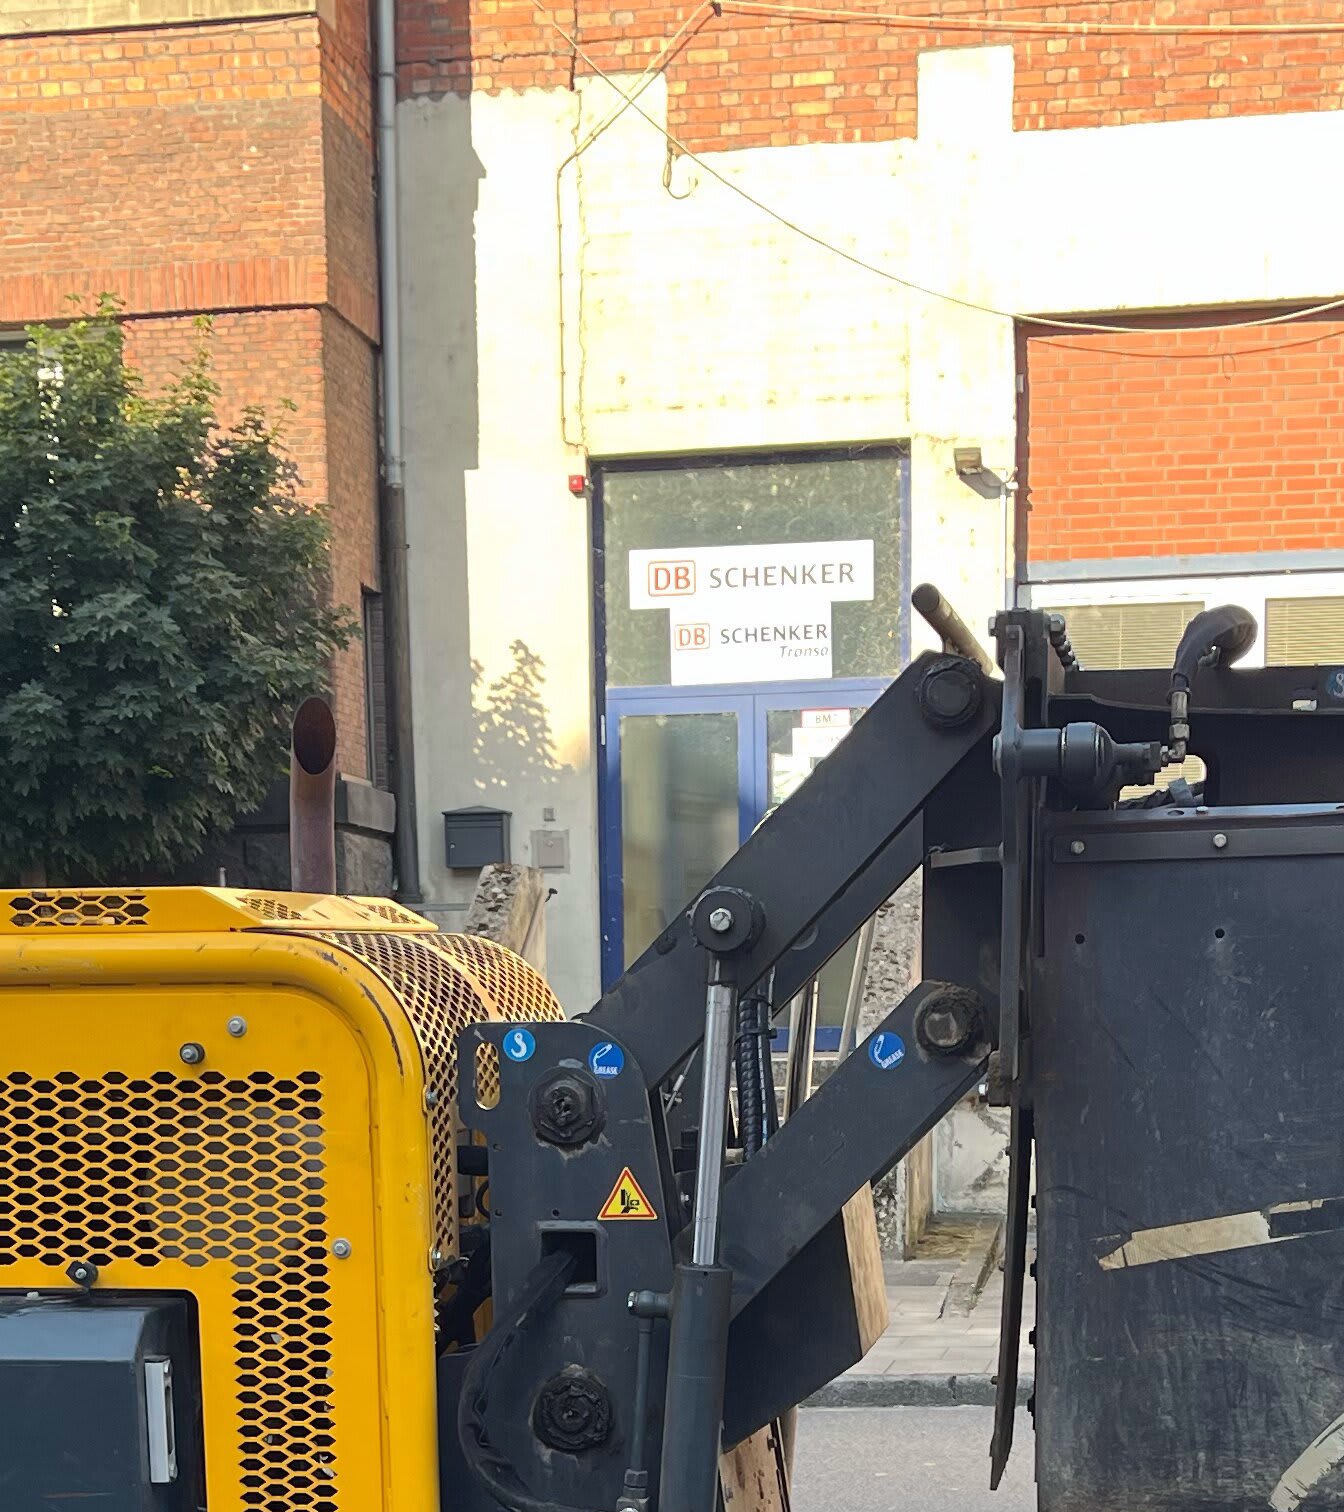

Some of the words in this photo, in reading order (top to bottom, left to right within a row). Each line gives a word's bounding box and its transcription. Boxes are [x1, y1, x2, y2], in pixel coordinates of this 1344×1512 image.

[653, 566, 692, 592] DB
[709, 563, 855, 588] SCHENKER
[678, 627, 706, 647] DB
[720, 624, 828, 645] SCHENKER
